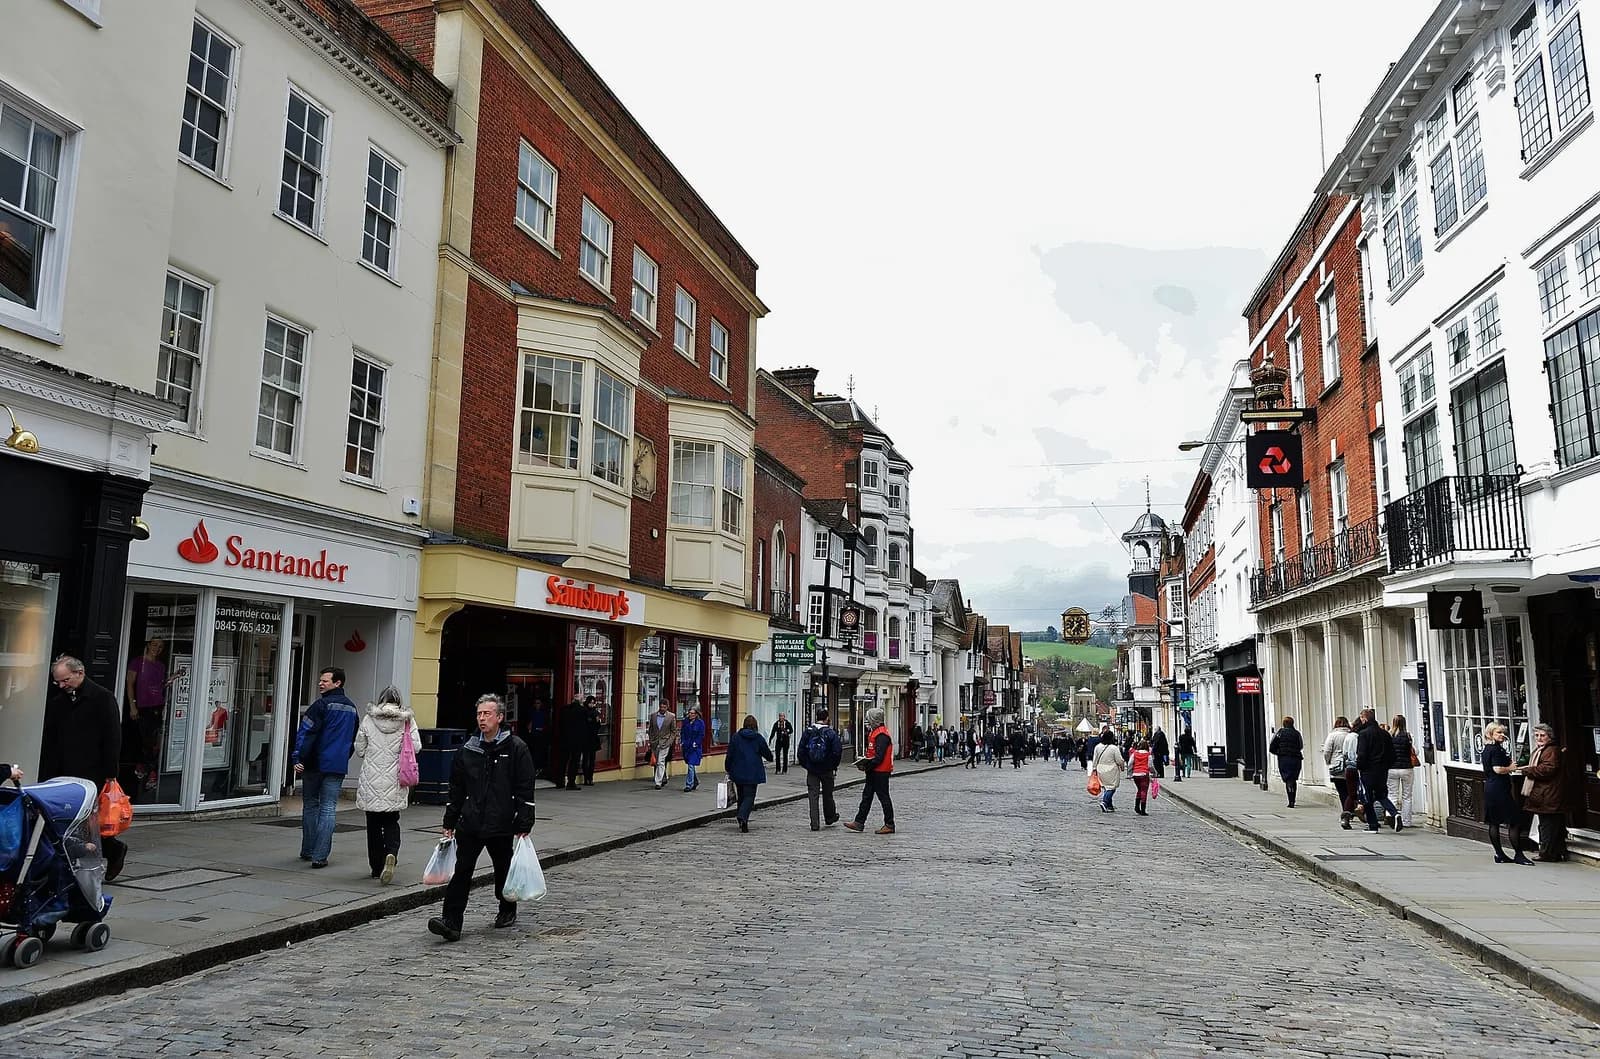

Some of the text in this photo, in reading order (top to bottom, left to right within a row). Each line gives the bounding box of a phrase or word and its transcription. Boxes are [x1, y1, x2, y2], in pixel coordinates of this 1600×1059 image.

[224, 534, 349, 583] Santander
[546, 575, 630, 620] Sainsbury's
[215, 620, 274, 634] 0845 765 4321
[216, 607, 281, 621] santander.co.uk
